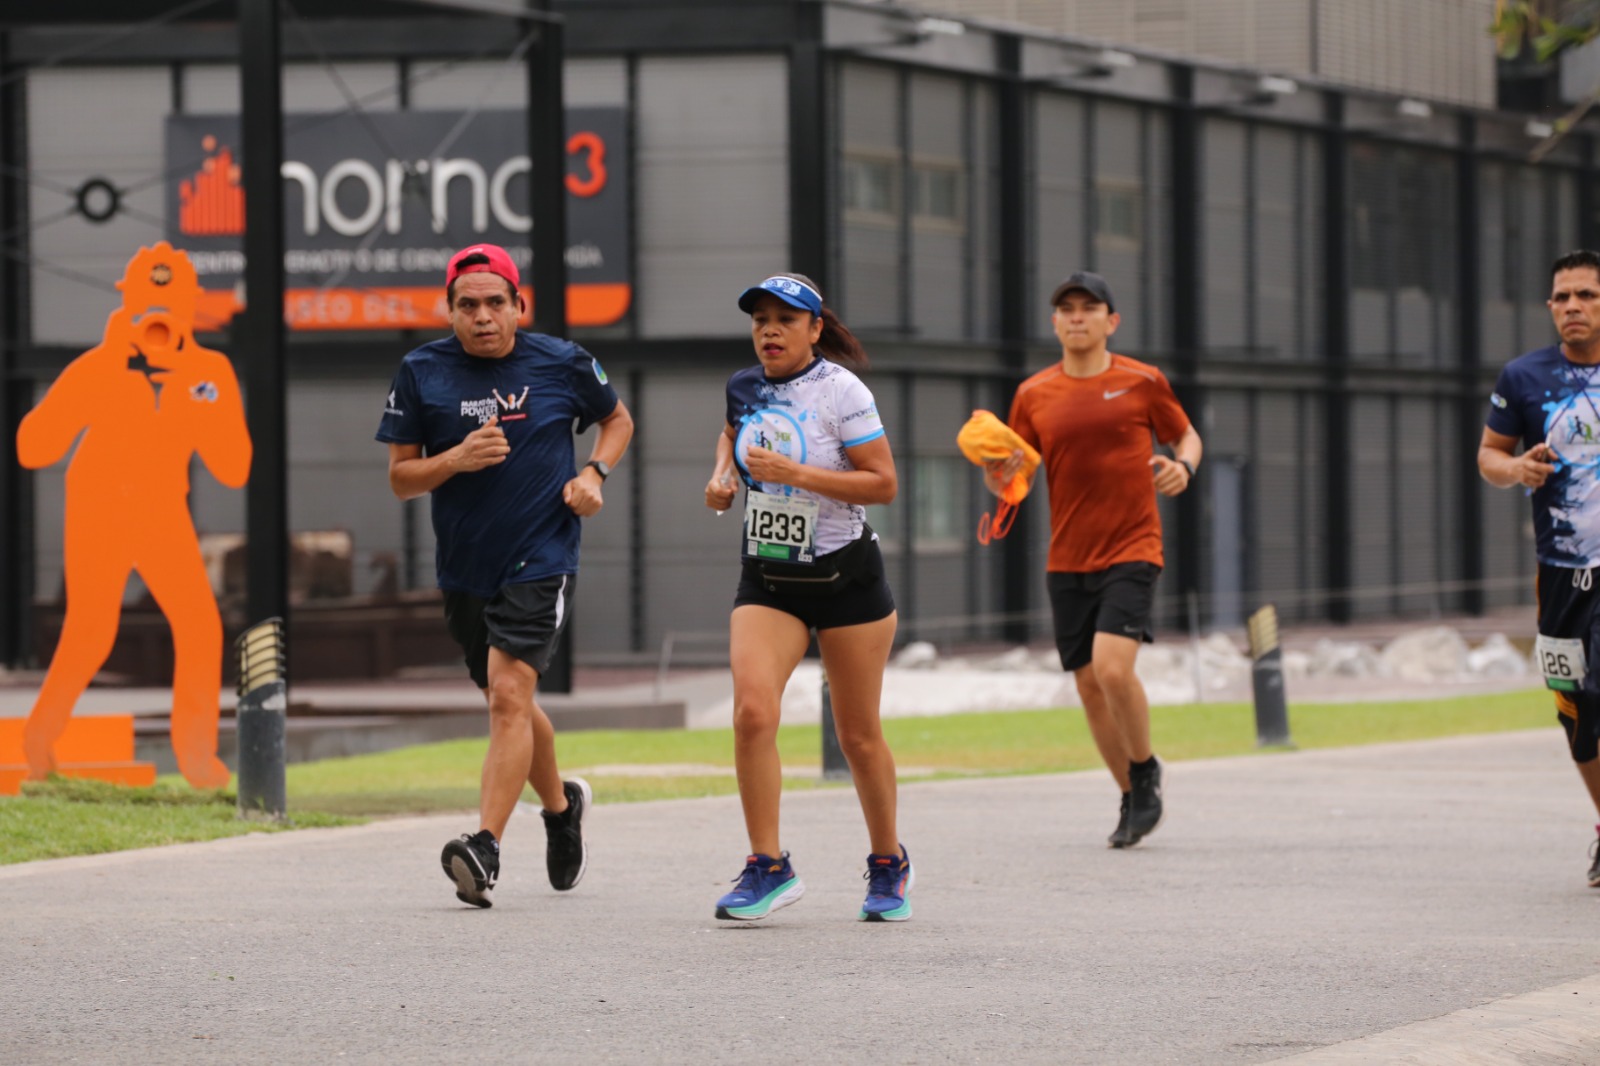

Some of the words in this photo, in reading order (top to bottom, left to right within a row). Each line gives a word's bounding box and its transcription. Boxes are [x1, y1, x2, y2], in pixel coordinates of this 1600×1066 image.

[461, 405, 499, 417] POWER
[750, 508, 806, 543] 1233
[1540, 648, 1572, 677] 126
